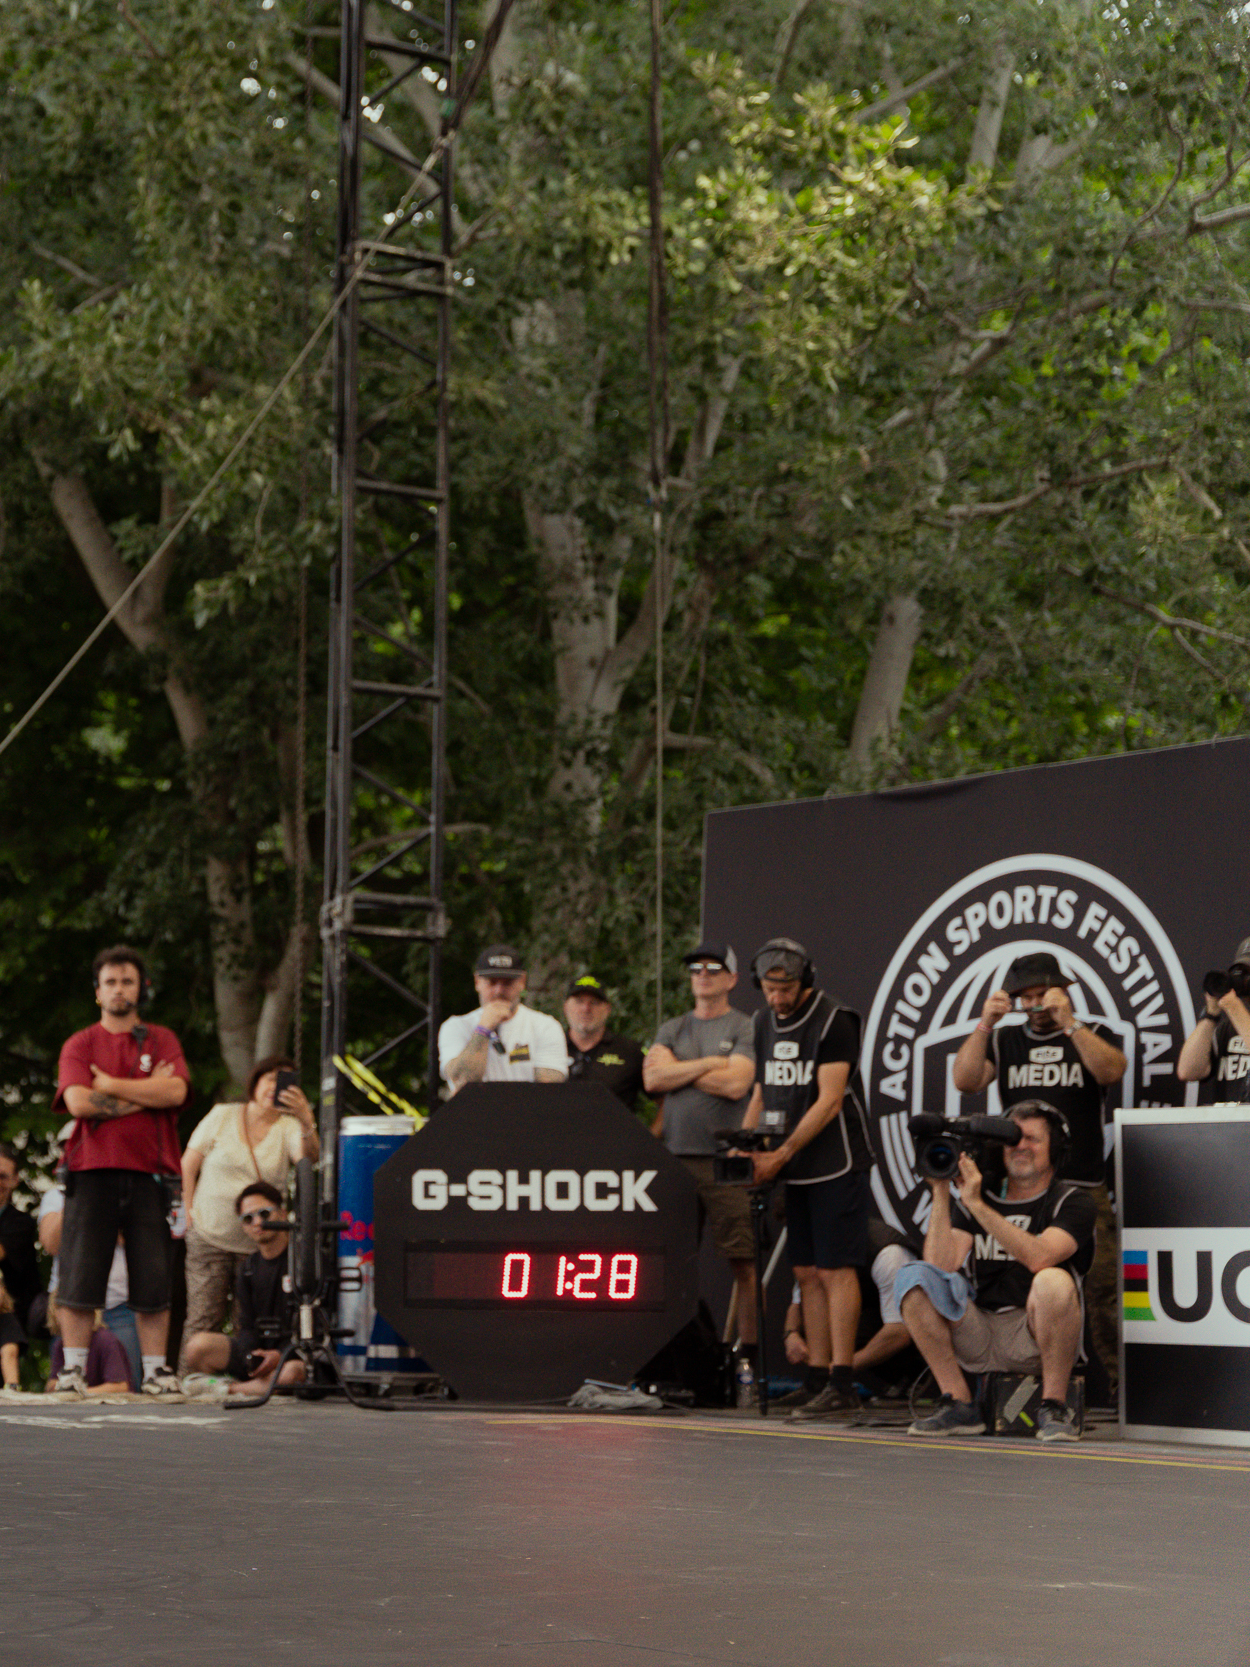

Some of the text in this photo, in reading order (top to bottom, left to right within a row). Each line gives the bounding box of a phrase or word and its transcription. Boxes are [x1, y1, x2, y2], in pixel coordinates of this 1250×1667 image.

[880, 884, 1174, 1102] ACTION SPORTS FESTIVAL
[1008, 1062, 1085, 1090] MEDIA
[411, 1169, 658, 1212] G-SHOCK
[501, 1253, 638, 1299] 01:28
